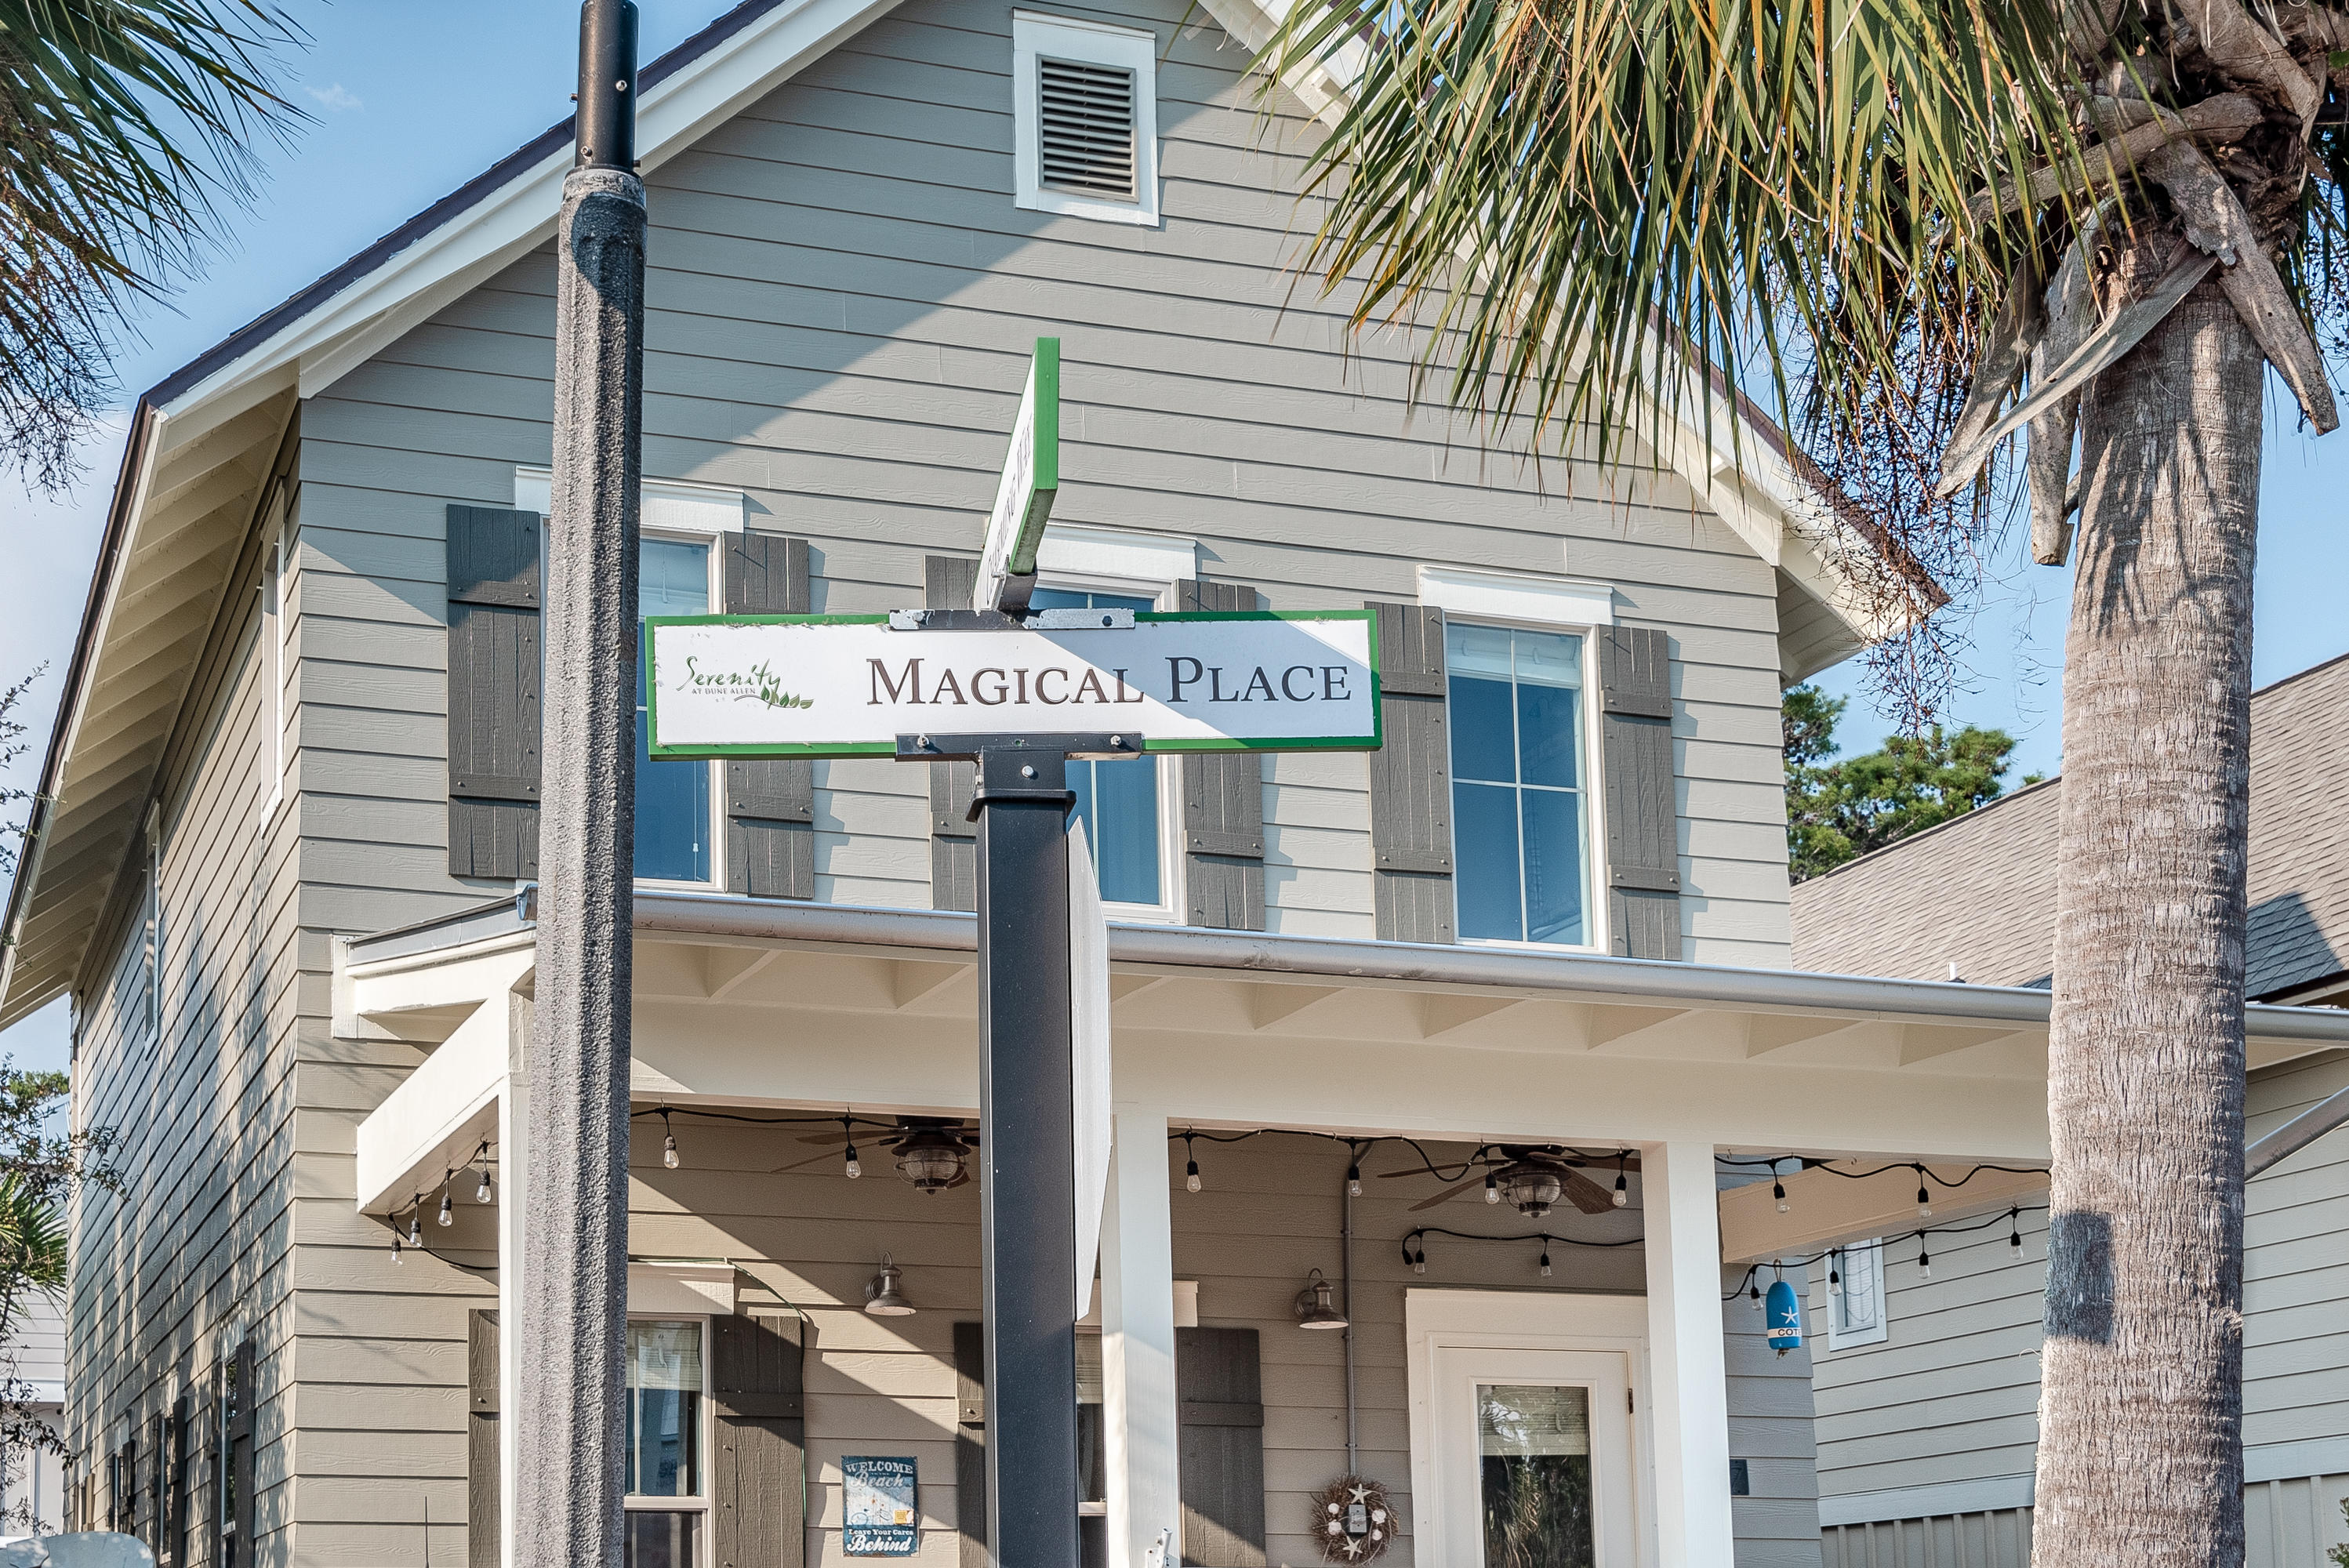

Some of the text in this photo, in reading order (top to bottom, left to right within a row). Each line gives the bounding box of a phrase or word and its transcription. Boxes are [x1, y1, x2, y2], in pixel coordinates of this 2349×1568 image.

[677, 655, 781, 710] Serenity
[866, 657, 1352, 705] MAGICAL PLACE
[845, 1461, 913, 1474] WELCOME
[850, 1472, 904, 1487] Beach
[847, 1536, 912, 1552] Behind
